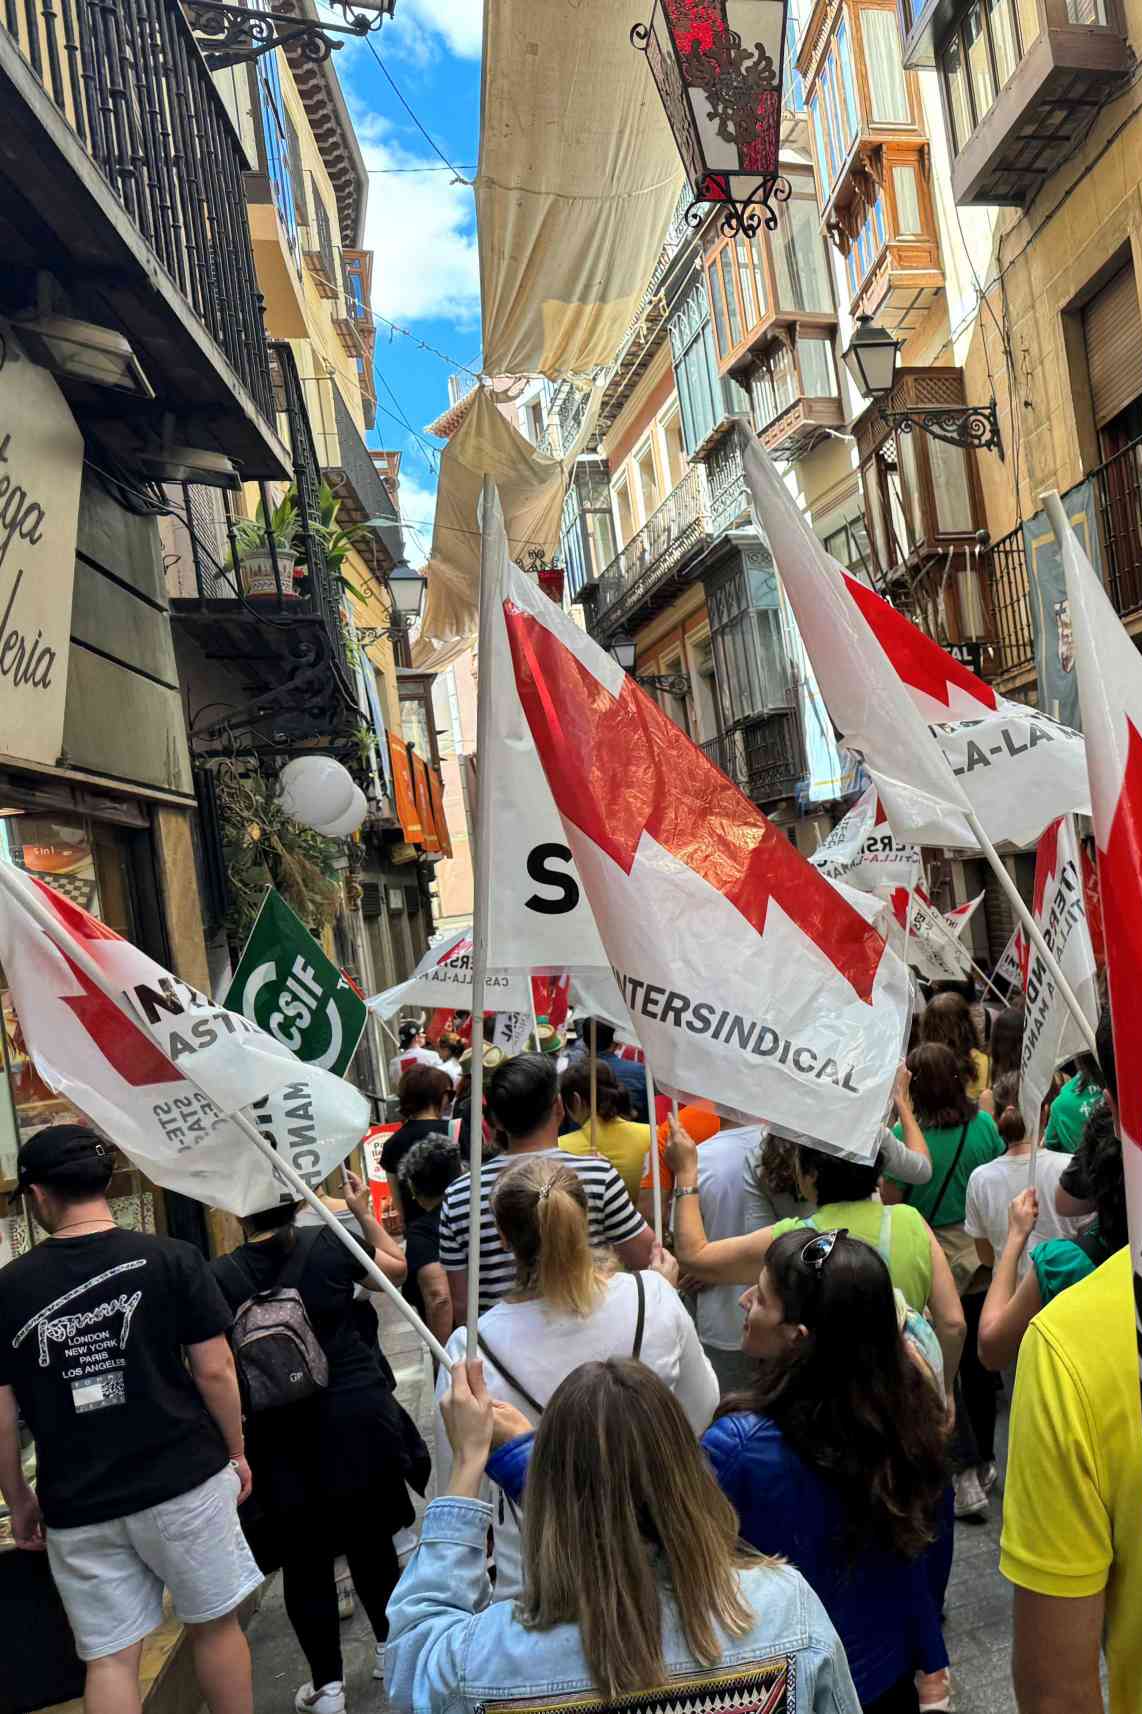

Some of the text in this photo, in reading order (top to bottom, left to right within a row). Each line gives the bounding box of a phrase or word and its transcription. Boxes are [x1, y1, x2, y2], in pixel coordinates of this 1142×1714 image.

[269, 954, 324, 1052] CSIF
[611, 966, 862, 1094] NTERSINDICAL
[65, 1338, 118, 1358] NEW YORK
[67, 1330, 110, 1346] LONDON
[79, 1350, 109, 1365] PARIS
[62, 1358, 127, 1379] LOS ANGELES
